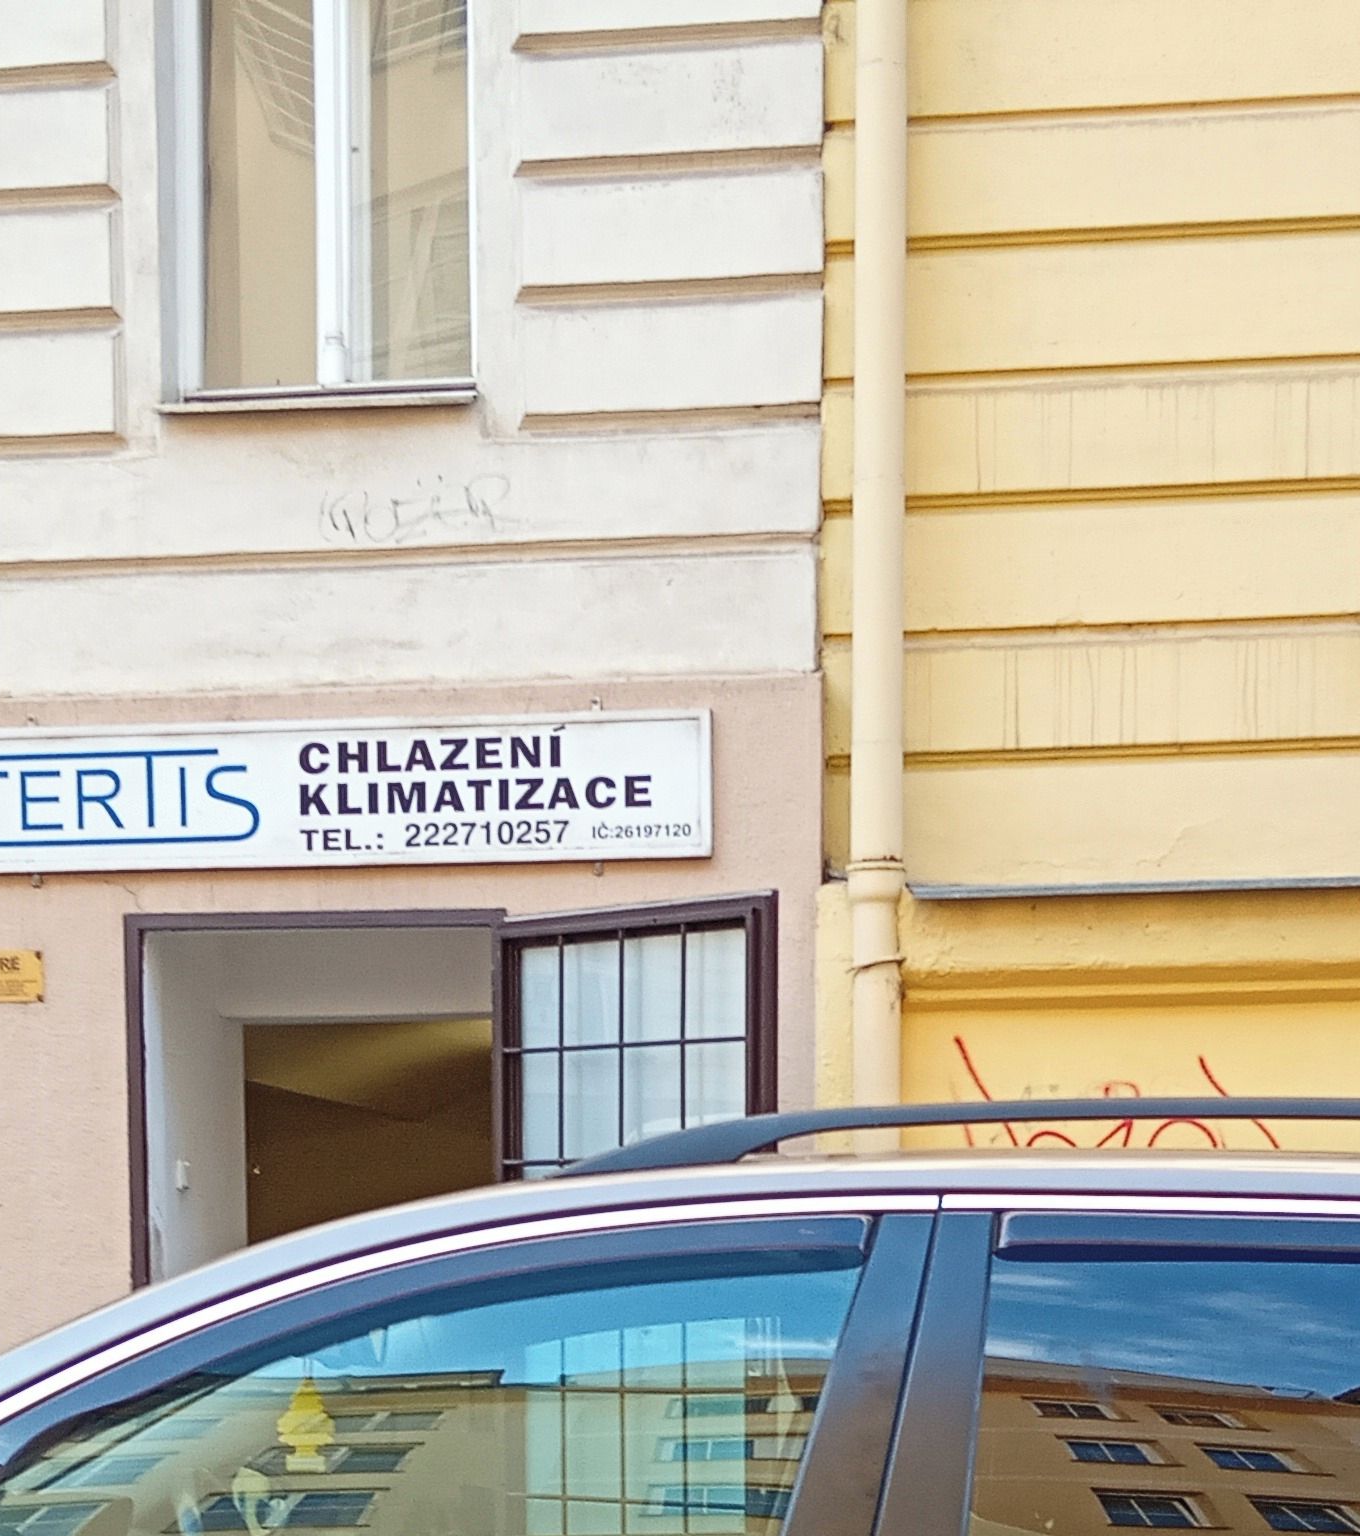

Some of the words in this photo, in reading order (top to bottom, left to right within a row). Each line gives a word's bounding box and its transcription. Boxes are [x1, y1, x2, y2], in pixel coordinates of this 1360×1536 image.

[298, 725, 567, 774] CHLAZENÍ
[298, 774, 653, 816] KLIMATIZACE
[298, 828, 385, 852] TEL.:
[404, 819, 570, 848] 222710257
